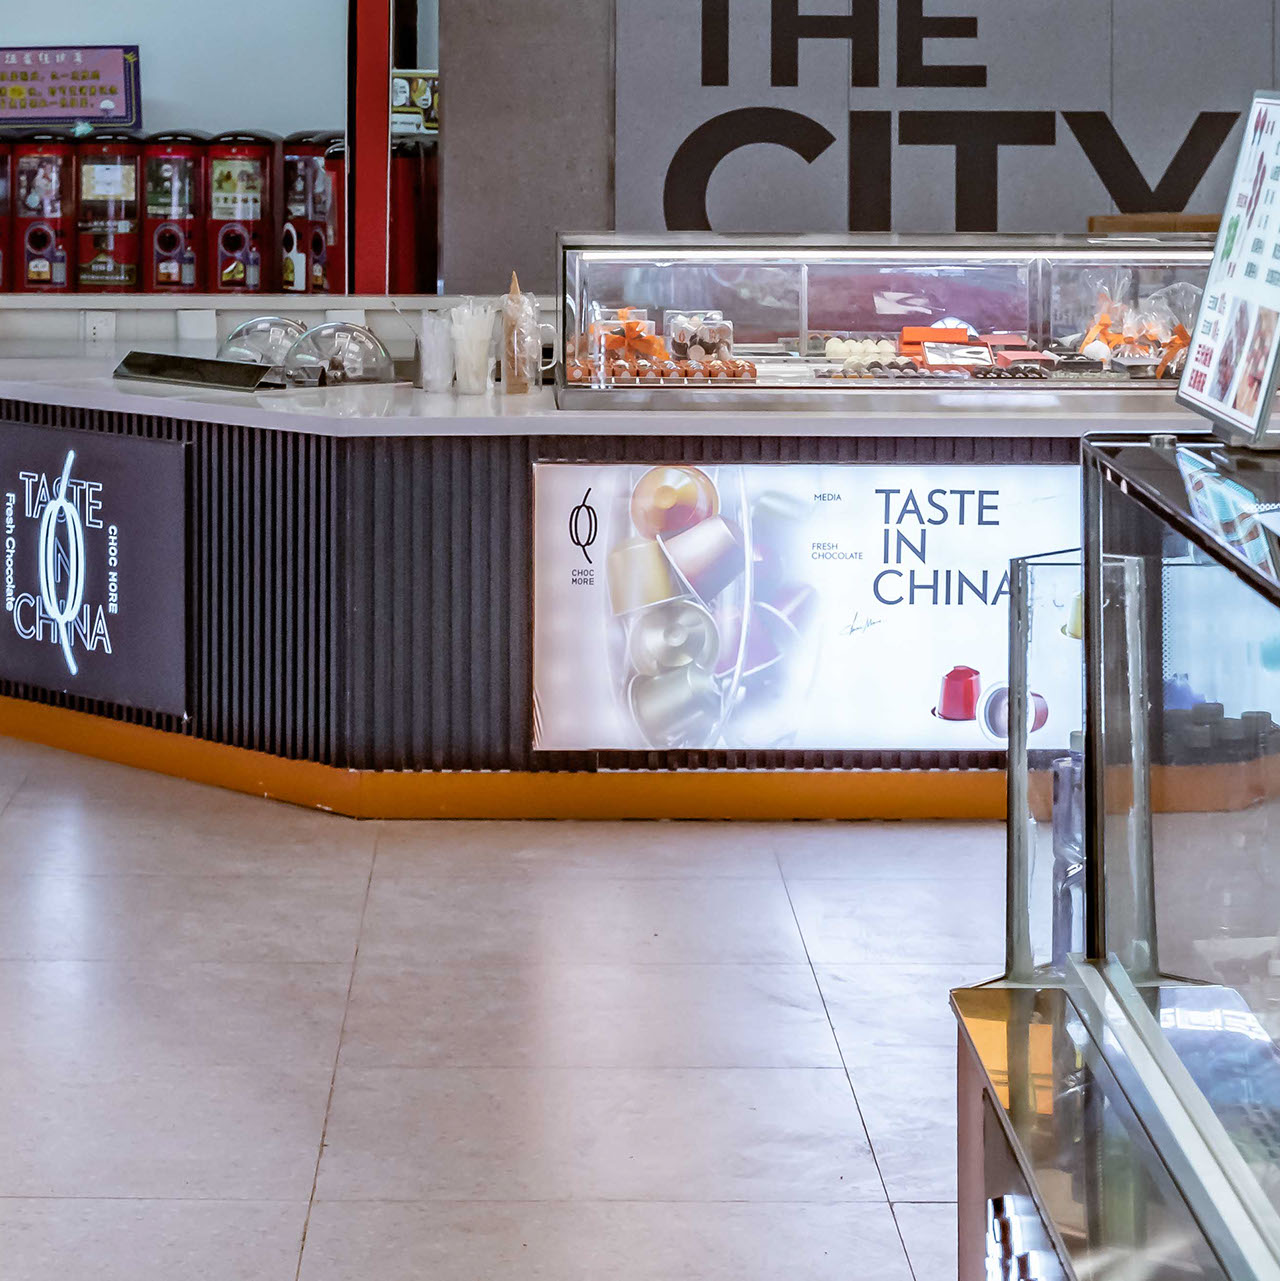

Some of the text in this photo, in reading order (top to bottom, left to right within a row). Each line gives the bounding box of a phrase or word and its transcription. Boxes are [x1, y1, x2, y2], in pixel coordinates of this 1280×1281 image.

[814, 493, 842, 502] MEDIA
[875, 488, 1000, 526] TASTE
[811, 542, 838, 551] FRESH
[883, 528, 927, 565] IN
[5, 492, 16, 612] Fresh Chocolate
[811, 551, 864, 561] CHOCOLATE
[107, 525, 118, 615] CHOC MORE
[571, 569, 595, 577] CHOC
[571, 577, 595, 586] MORE
